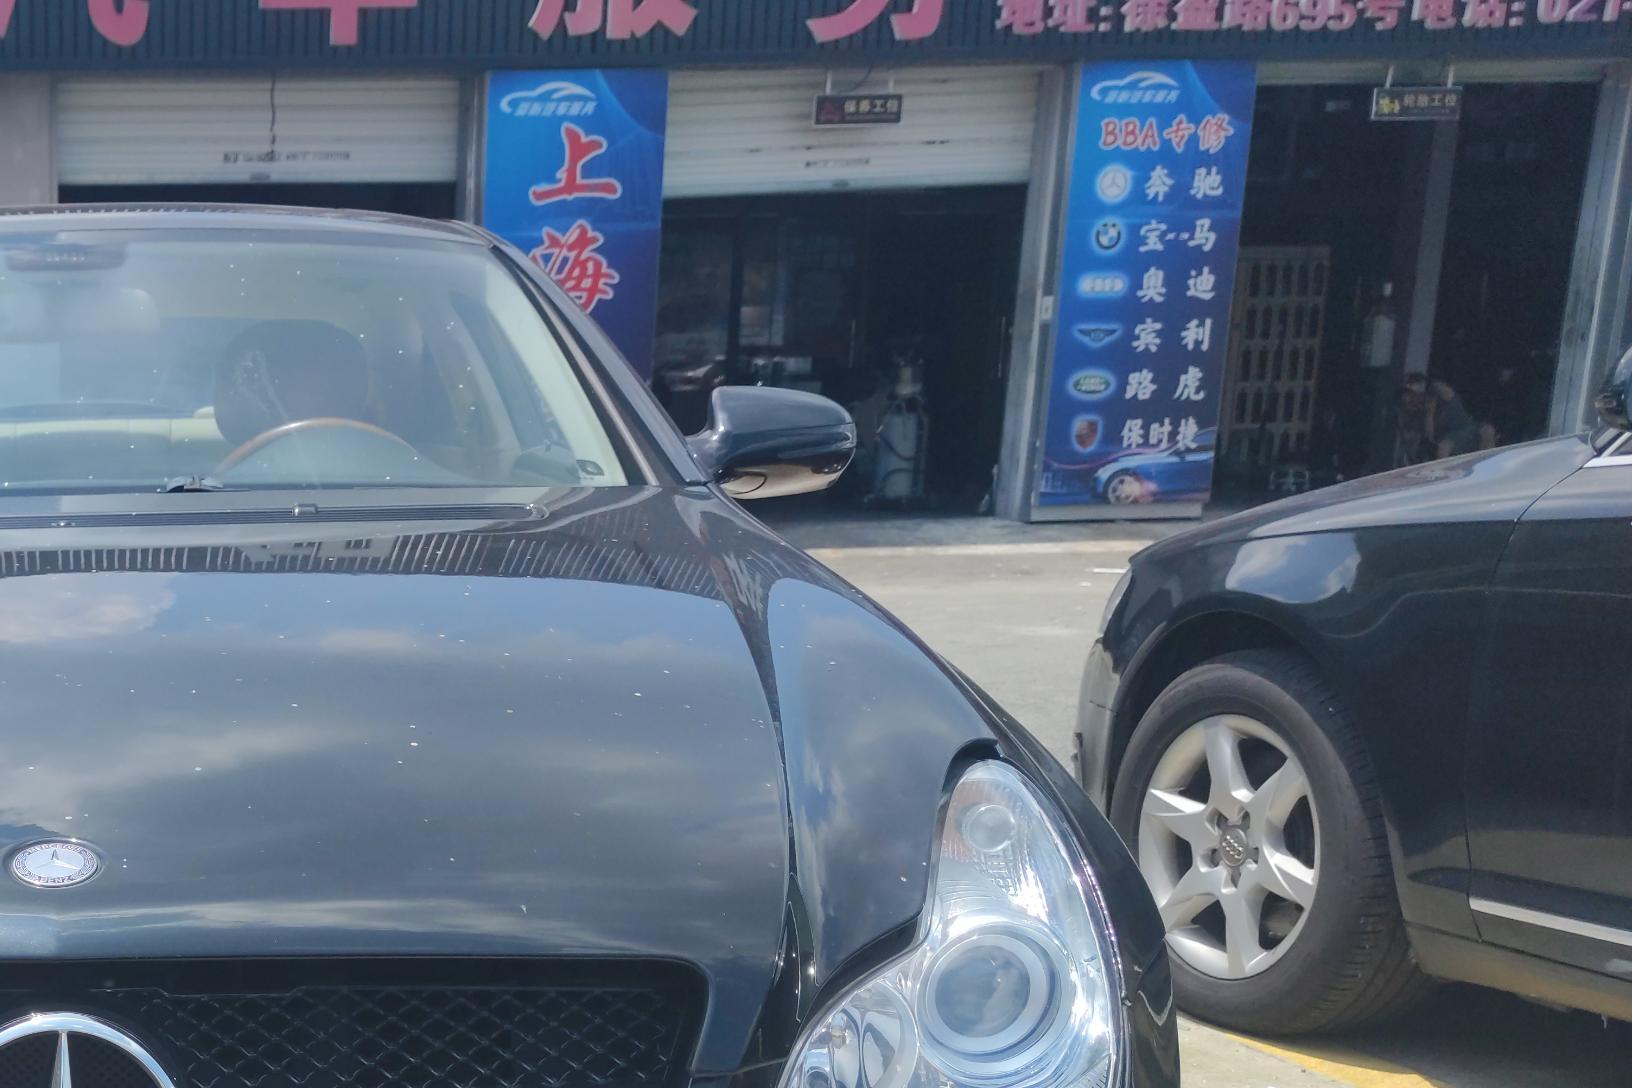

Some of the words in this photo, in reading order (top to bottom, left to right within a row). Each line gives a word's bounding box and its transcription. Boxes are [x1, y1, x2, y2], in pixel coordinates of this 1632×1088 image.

[1099, 113, 1234, 154] BBA专修
[1144, 165, 1224, 202] 奔驰
[1135, 266, 1216, 302] 奥迪
[1131, 317, 1213, 352] 宾利
[1124, 366, 1206, 402] 路虎
[1120, 415, 1199, 451] 保时捷
